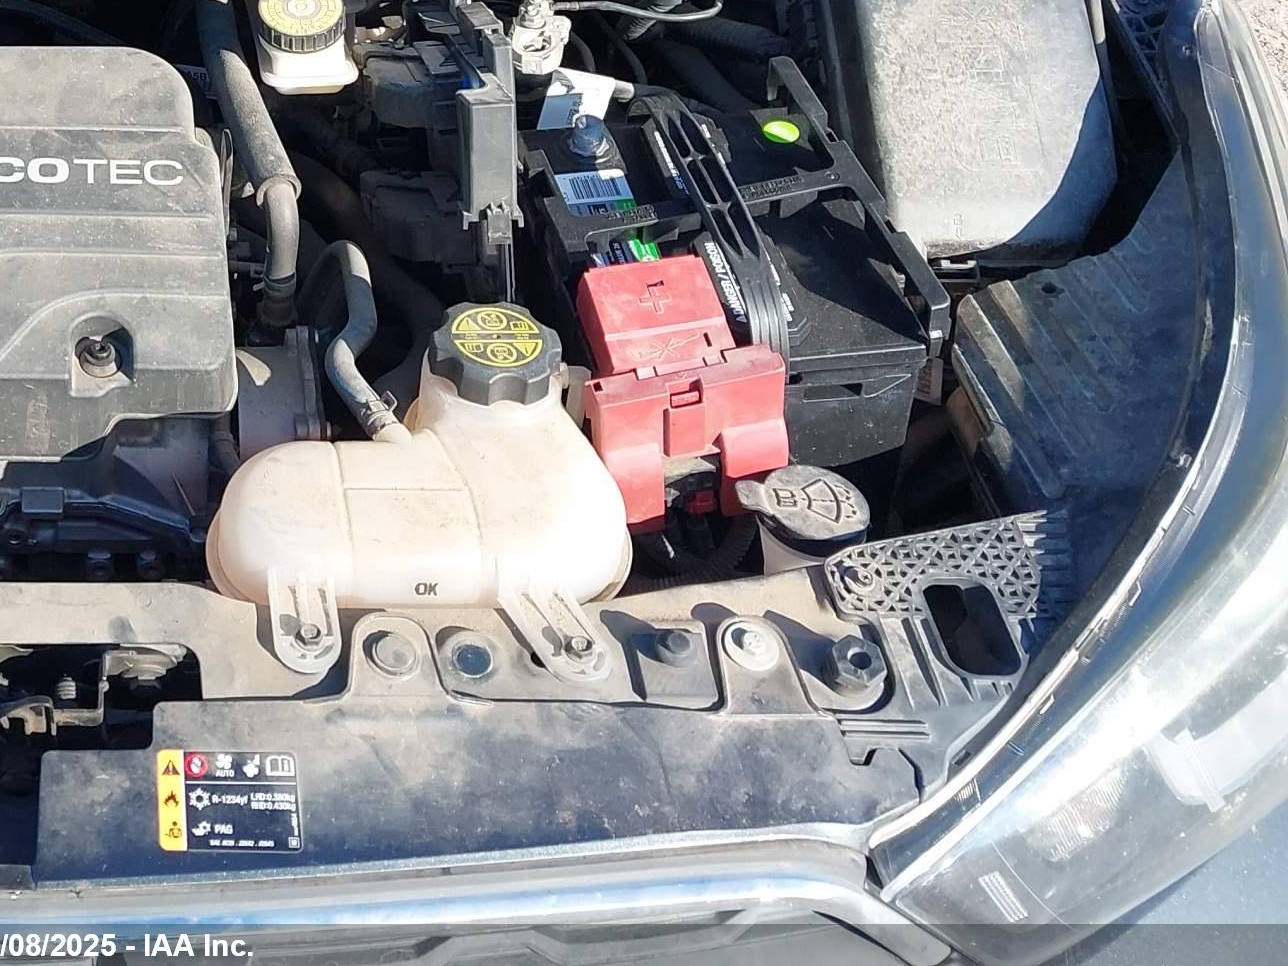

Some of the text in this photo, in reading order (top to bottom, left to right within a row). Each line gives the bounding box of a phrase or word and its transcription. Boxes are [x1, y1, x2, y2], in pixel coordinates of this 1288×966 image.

[704, 242, 726, 274] POISON
[720, 280, 744, 316] DANGER
[414, 582, 439, 596] OK
[215, 769, 235, 778] AUTO
[214, 824, 234, 835] PAG
